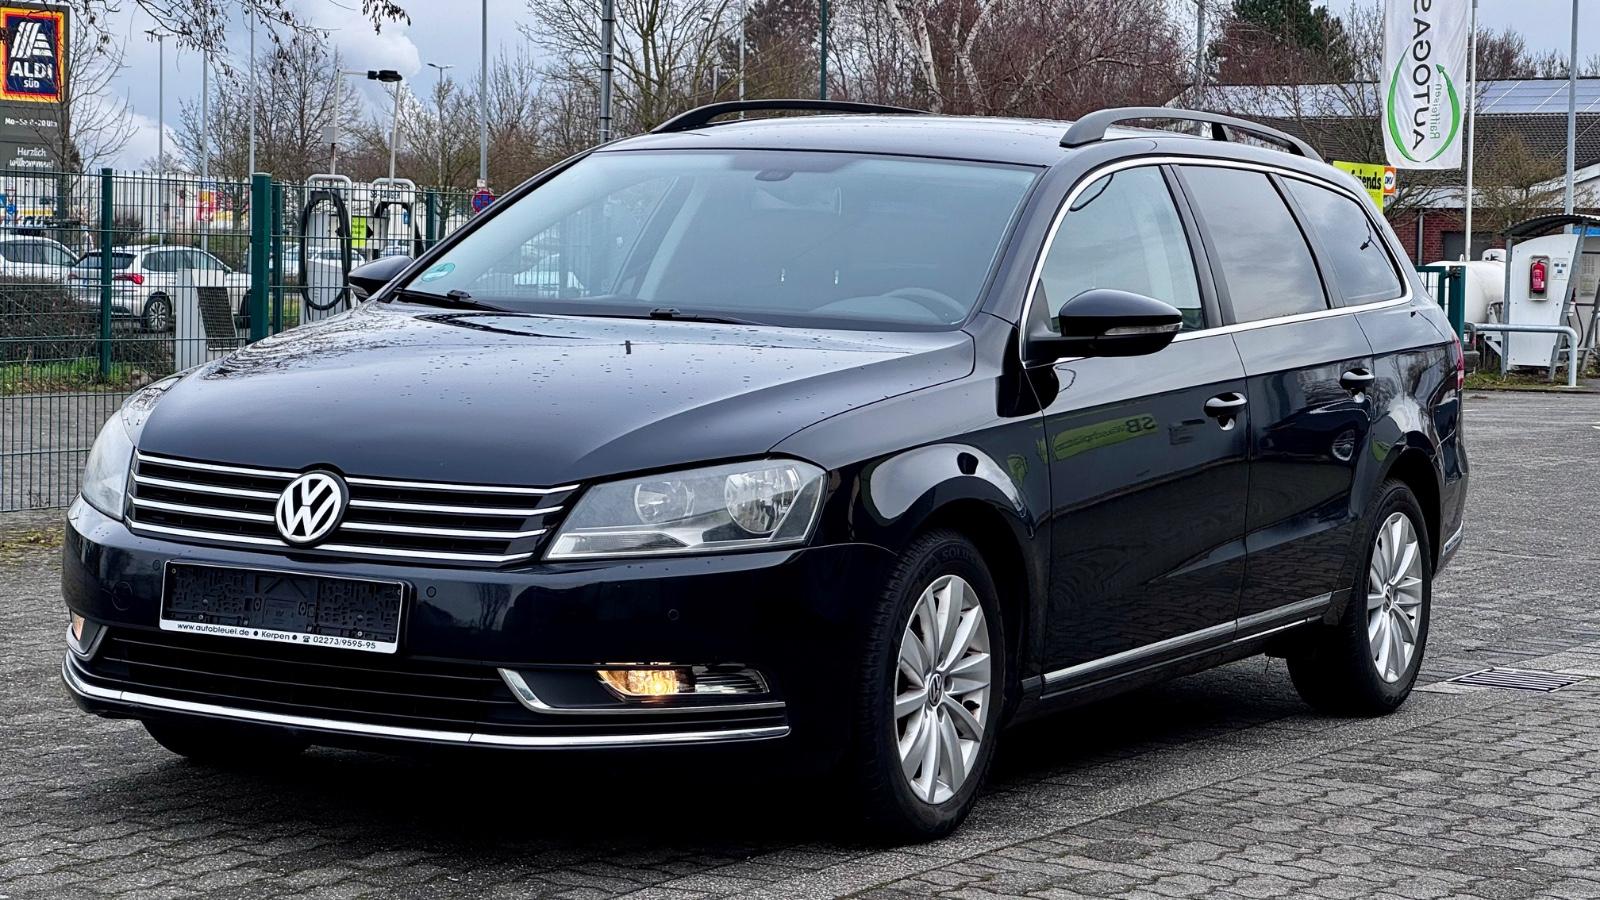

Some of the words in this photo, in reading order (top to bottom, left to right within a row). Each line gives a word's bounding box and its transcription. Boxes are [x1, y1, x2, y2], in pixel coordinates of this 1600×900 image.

[10, 61, 53, 79] ALDI
[23, 78, 40, 88] SÜD
[17, 146, 47, 157] Herzlich
[276, 473, 341, 542] VW
[177, 623, 250, 636] www.autobleuel.de
[261, 631, 290, 641] Kerpen
[312, 635, 377, 650] 02273/9595-95
